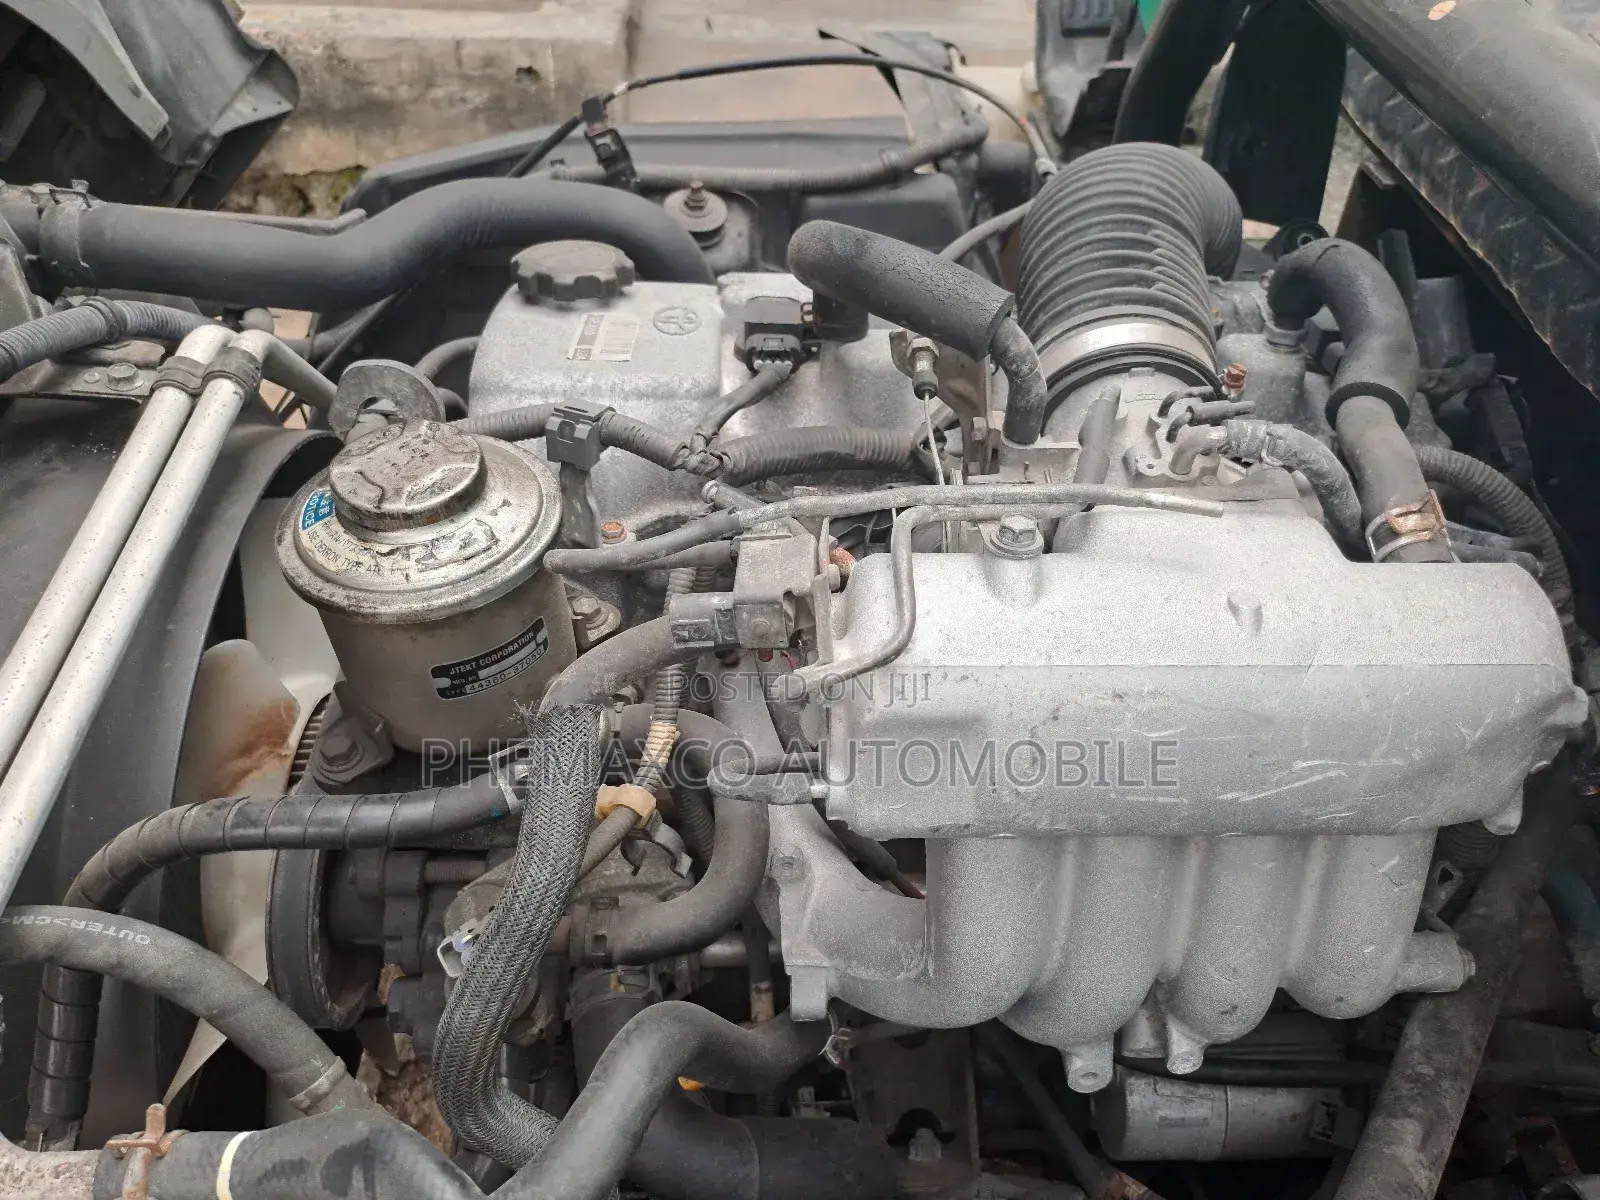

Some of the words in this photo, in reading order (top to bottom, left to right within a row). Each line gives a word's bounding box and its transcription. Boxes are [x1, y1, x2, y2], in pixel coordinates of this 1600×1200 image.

[341, 557, 363, 572] TYPE
[450, 662, 477, 675] JTEKT
[480, 631, 534, 666] CORPORATION
